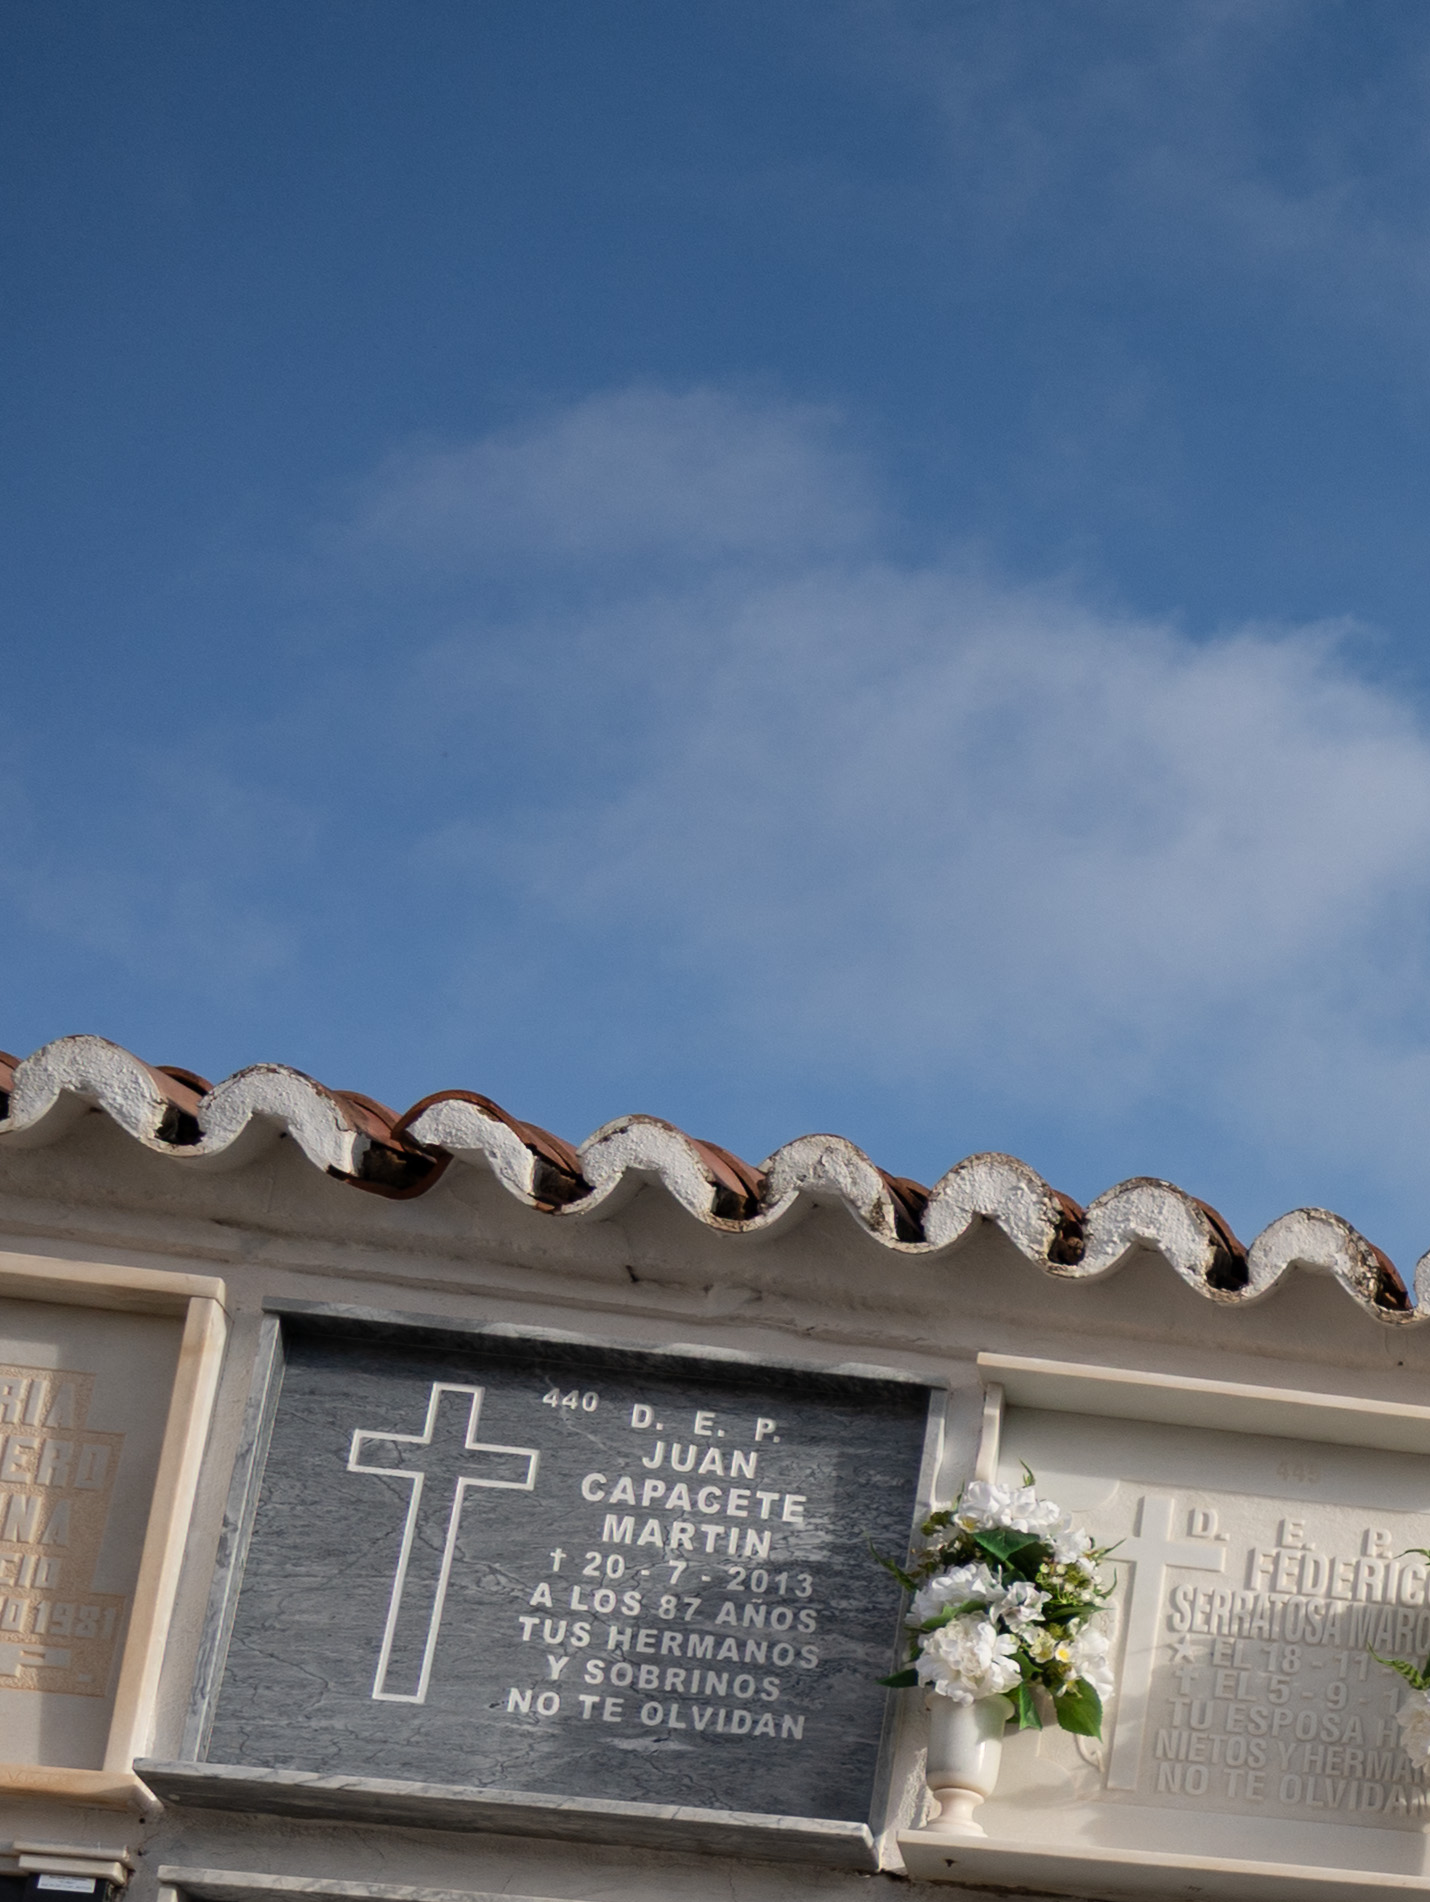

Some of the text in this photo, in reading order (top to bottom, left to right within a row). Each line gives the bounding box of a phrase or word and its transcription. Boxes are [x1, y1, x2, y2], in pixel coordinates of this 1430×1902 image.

[543, 1388, 599, 1412] 440
[642, 1441, 758, 1479] JUAN
[581, 1473, 807, 1523] CAPACETE
[602, 1514, 772, 1558] MARTIN
[519, 1616, 819, 1669] TUS HERMANOS
